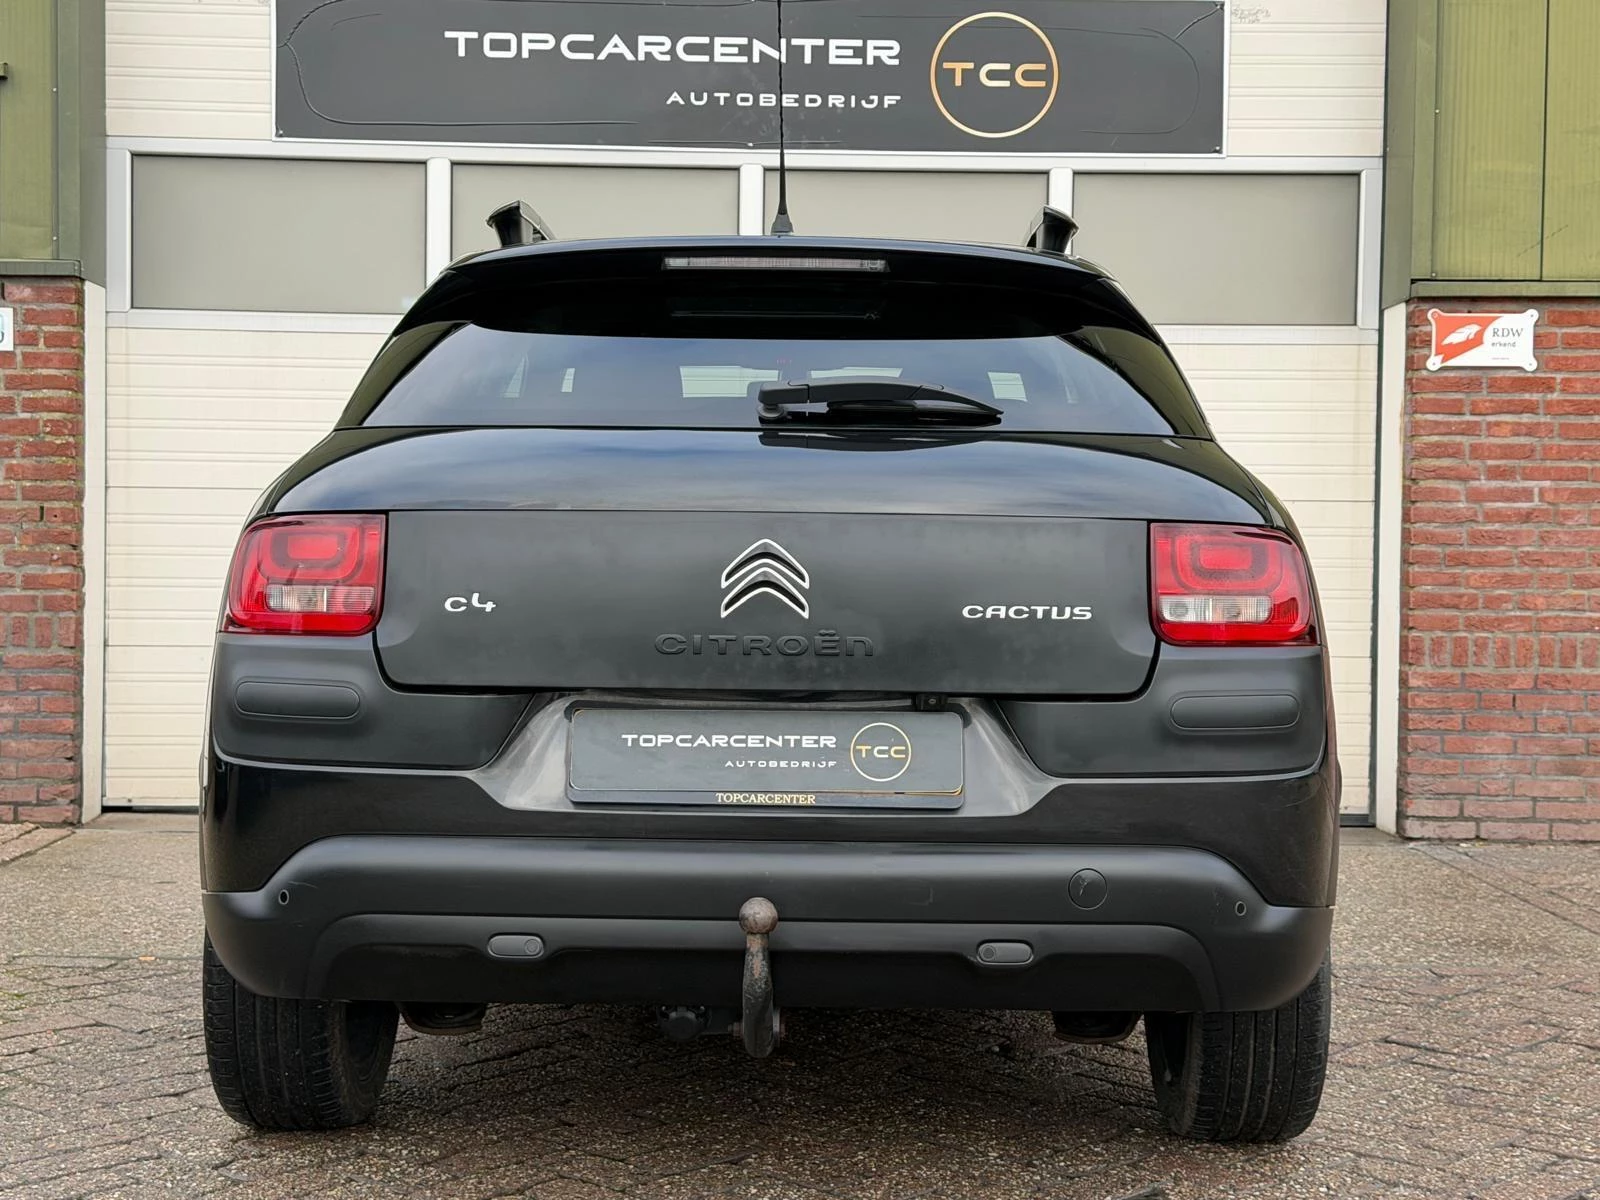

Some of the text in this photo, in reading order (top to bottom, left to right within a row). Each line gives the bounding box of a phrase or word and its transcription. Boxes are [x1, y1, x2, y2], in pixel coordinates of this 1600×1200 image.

[443, 30, 901, 66] TOPCARCENTER
[942, 61, 1047, 88] TCC
[665, 90, 902, 109] AUTOBEDRIJF
[1492, 327, 1524, 338] RDW
[444, 592, 497, 612] C4
[961, 605, 1093, 620] CACTUS
[621, 734, 837, 748] TOPCARCENTER
[855, 745, 906, 759] TCC
[724, 760, 837, 768] AUTOBEDRIJF
[715, 792, 816, 805] TOPCARCENTER
